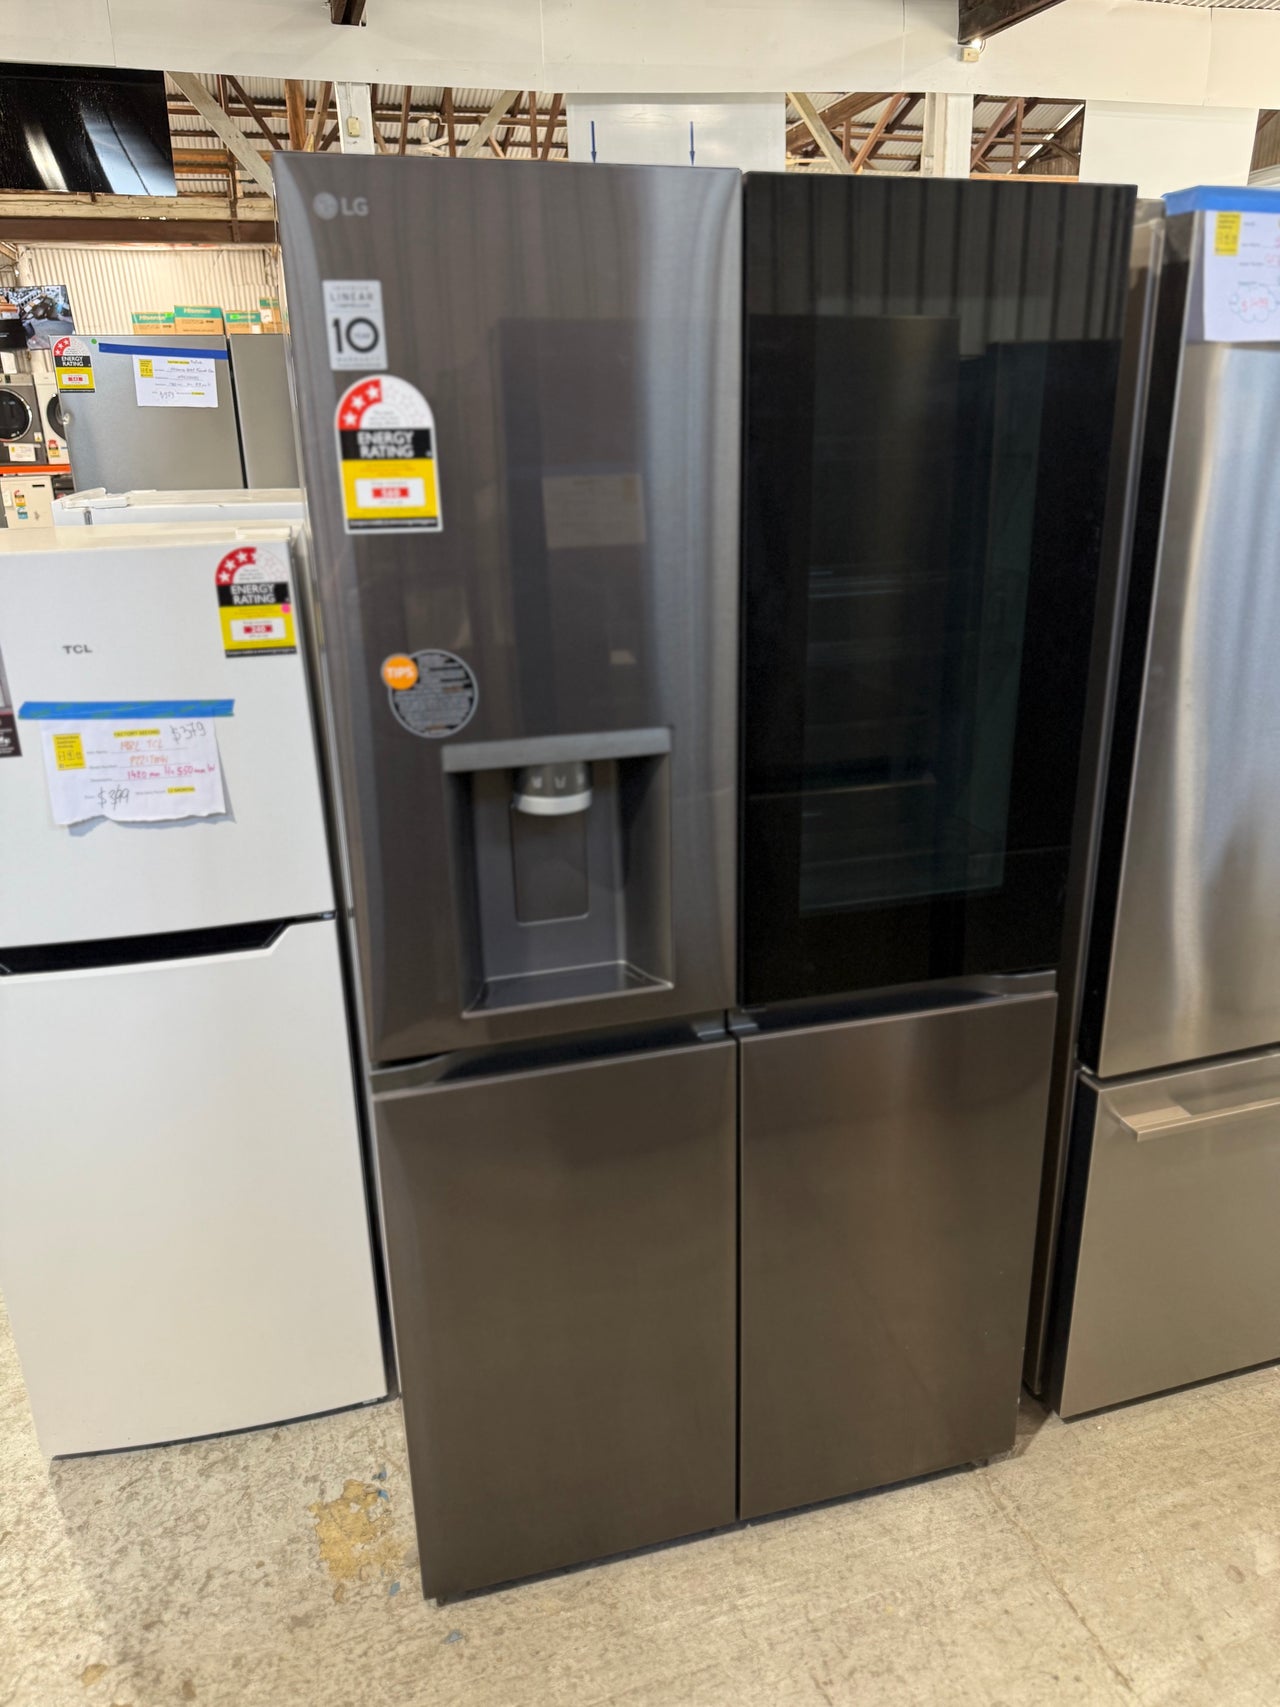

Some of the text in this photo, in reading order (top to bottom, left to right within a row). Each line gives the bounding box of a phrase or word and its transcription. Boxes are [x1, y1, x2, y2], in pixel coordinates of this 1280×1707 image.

[341, 197, 369, 216] LG
[329, 291, 374, 302] LINEAR
[333, 317, 380, 354] 10
[357, 431, 415, 446] ENERGY
[360, 444, 415, 459] RATING
[231, 584, 275, 595] ENERGY
[233, 594, 276, 605] RATING
[62, 644, 93, 655] TCL
